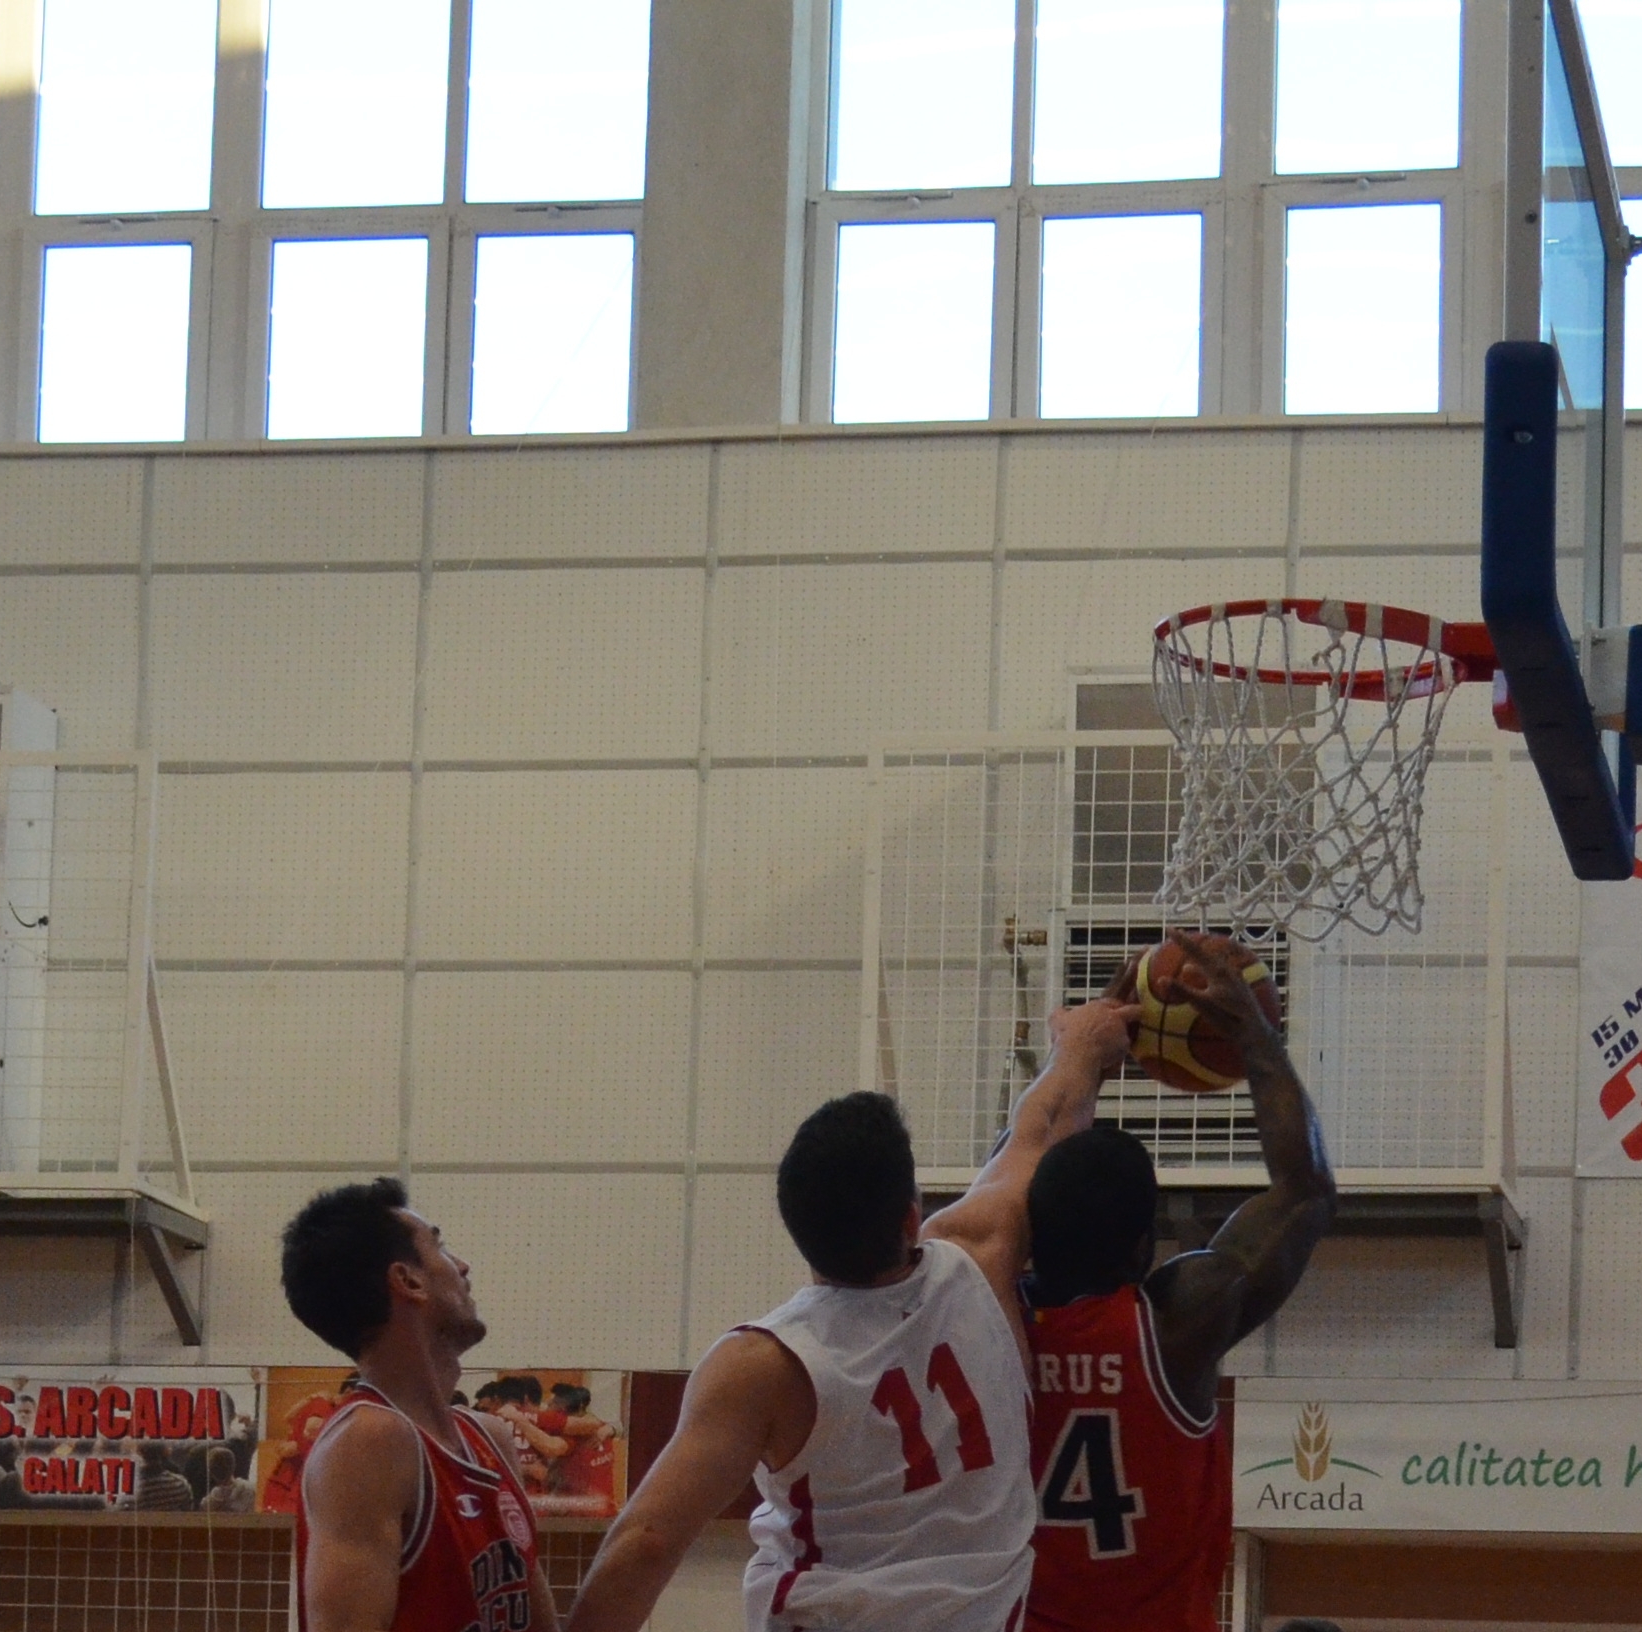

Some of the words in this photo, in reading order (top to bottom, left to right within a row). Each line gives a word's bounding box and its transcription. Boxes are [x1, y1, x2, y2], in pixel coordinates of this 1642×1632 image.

[1591, 1015, 1620, 1048] 15
[33, 1386, 225, 1440] ARCADA
[871, 1342, 995, 1493] 11
[1402, 1442, 1602, 1488] calitatea
[1257, 1483, 1364, 1512] Arcada
